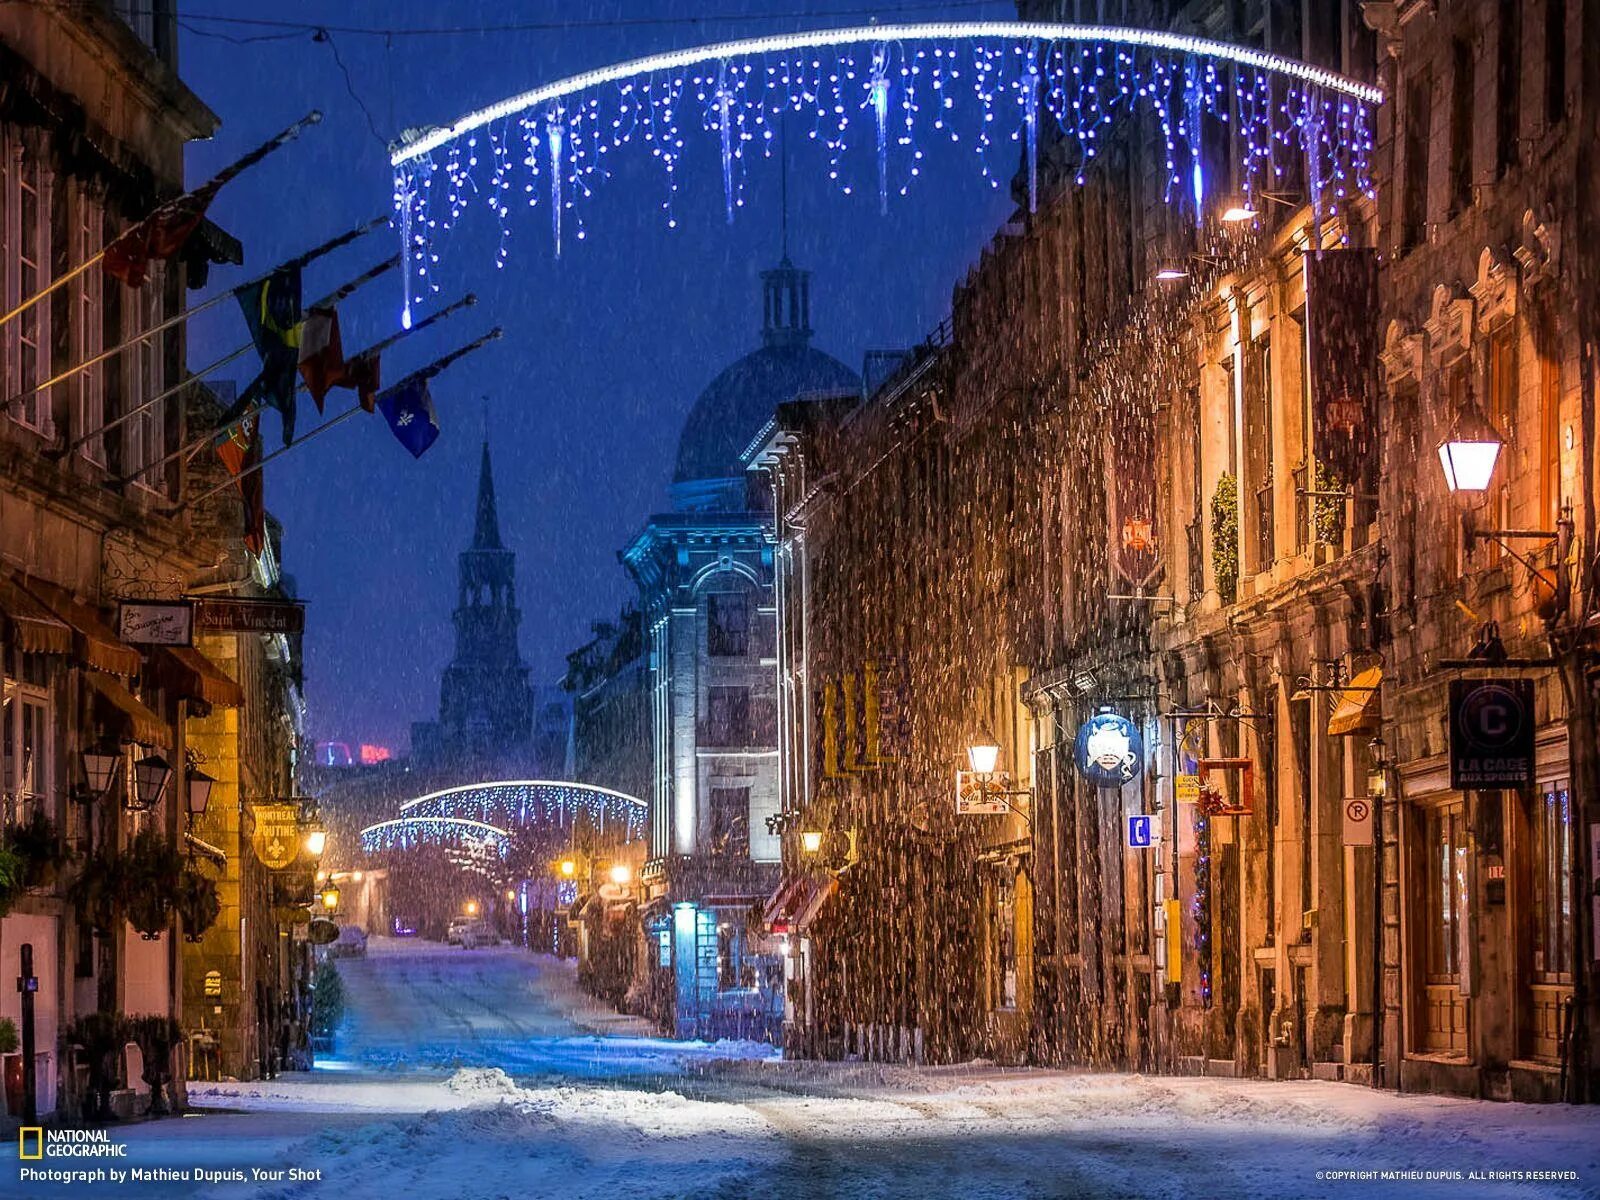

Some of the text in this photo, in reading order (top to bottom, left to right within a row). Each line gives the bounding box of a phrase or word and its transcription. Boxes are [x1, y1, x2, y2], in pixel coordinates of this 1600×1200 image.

[1458, 757, 1528, 771] LA CAGE
[1459, 772, 1528, 782] AUX SPORTS
[256, 825, 295, 837] POUTINE
